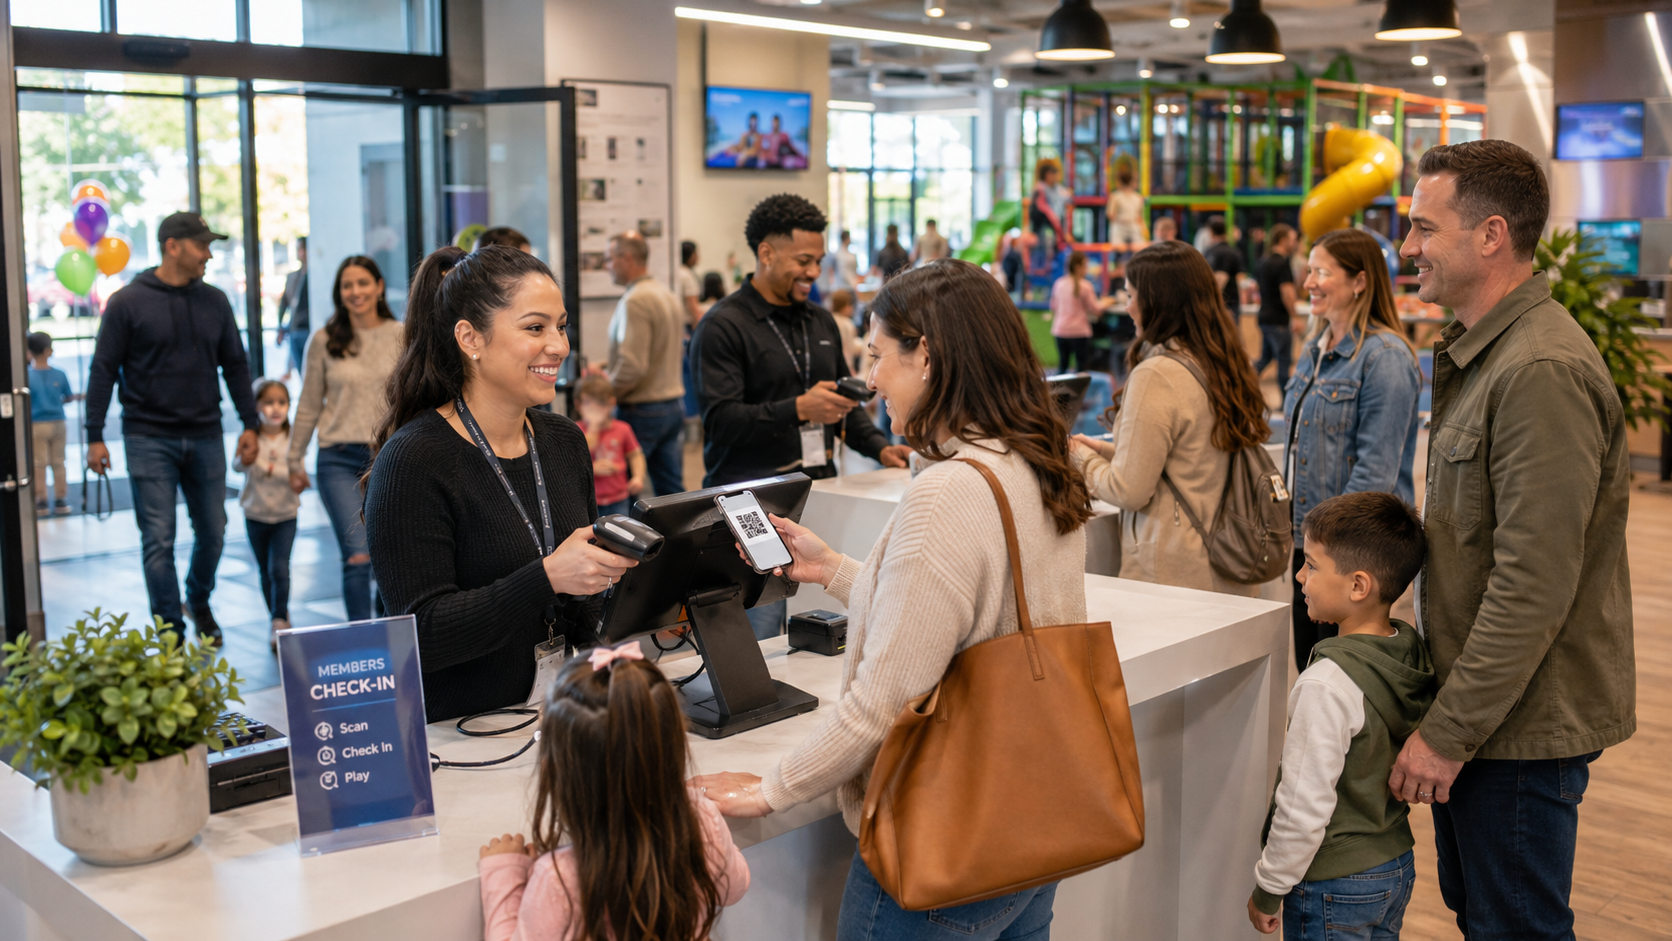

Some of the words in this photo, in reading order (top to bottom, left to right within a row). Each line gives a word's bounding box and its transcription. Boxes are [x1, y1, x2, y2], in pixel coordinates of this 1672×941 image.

[318, 658, 386, 677] MEMBERS
[310, 675, 395, 700] CHECK-IN
[340, 722, 369, 734] Scan
[342, 743, 379, 758] Check
[381, 742, 393, 752] In
[345, 771, 370, 783] Play
